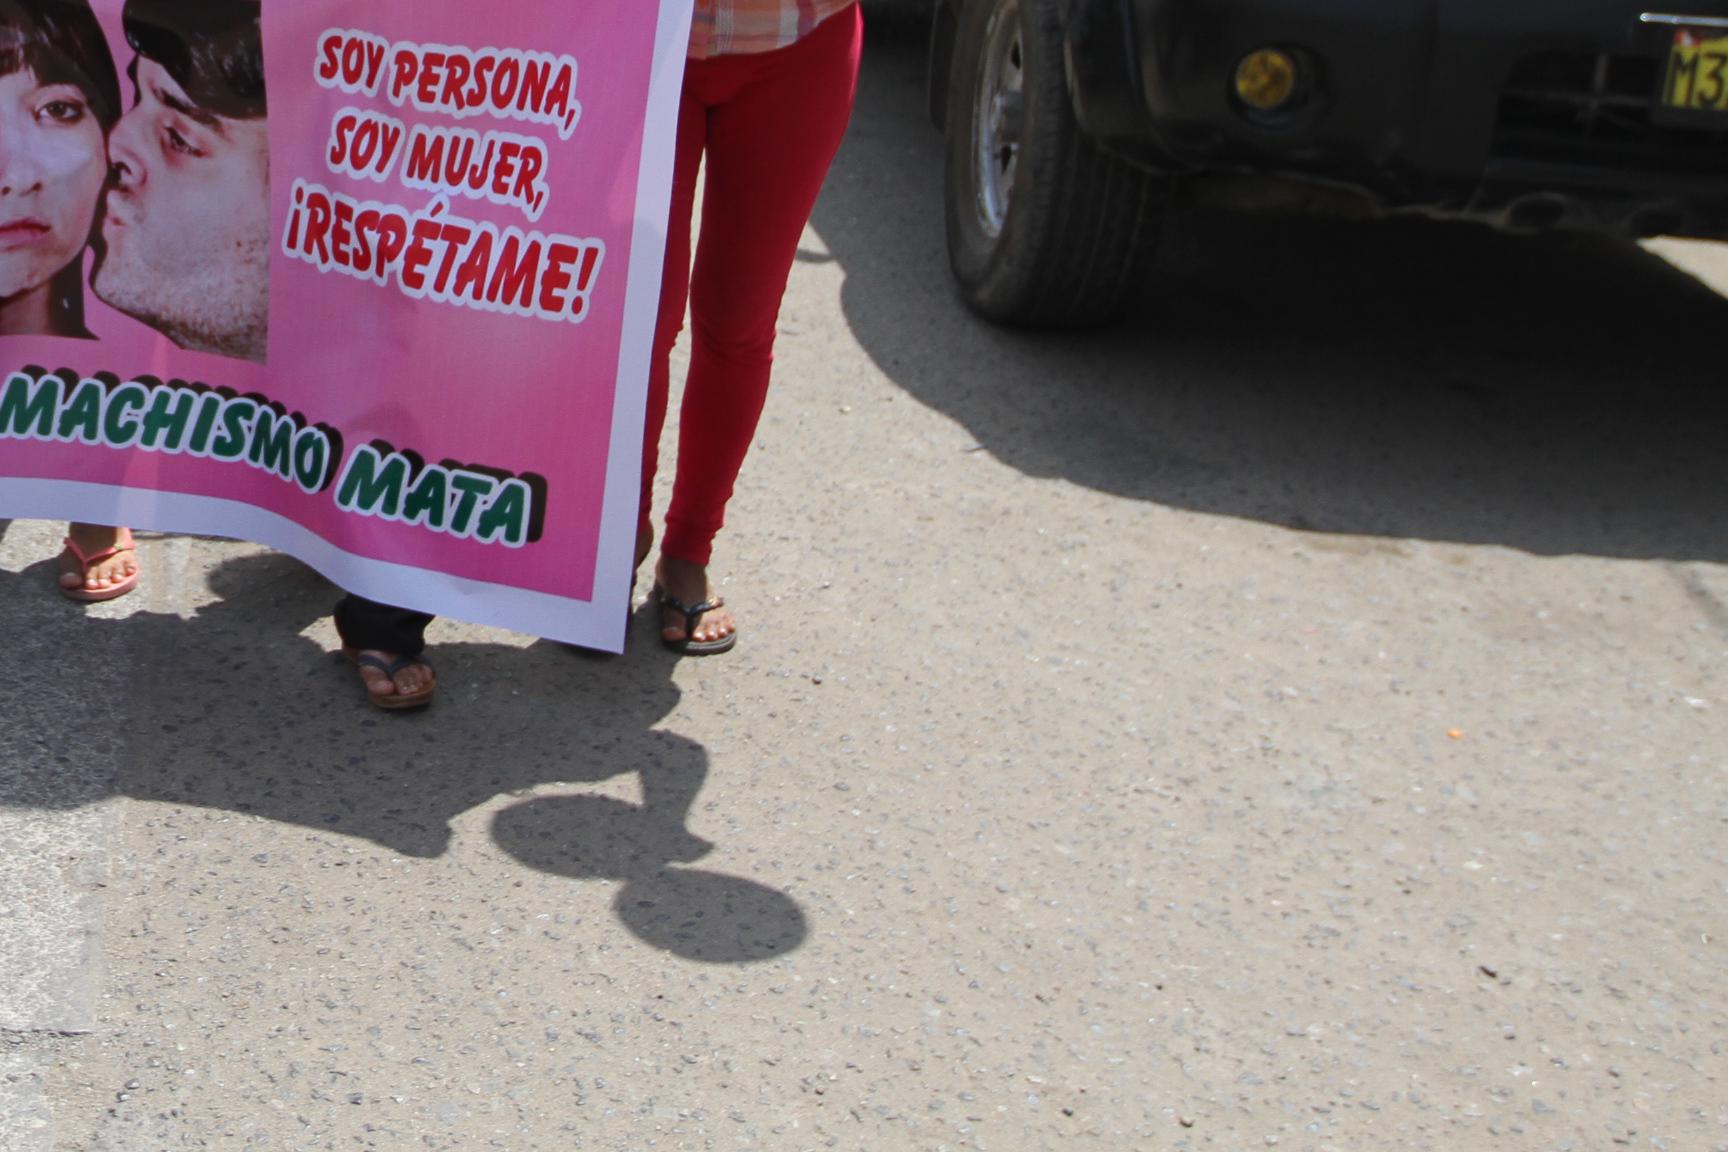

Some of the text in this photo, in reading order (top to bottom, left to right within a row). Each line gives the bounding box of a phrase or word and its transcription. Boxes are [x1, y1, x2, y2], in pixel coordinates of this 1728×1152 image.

[319, 34, 576, 131] SOY PERSONA,
[330, 114, 544, 213] SOY MUJER,
[286, 186, 599, 315] ¡RESPÉTAME!
[334, 443, 536, 549] MATA
